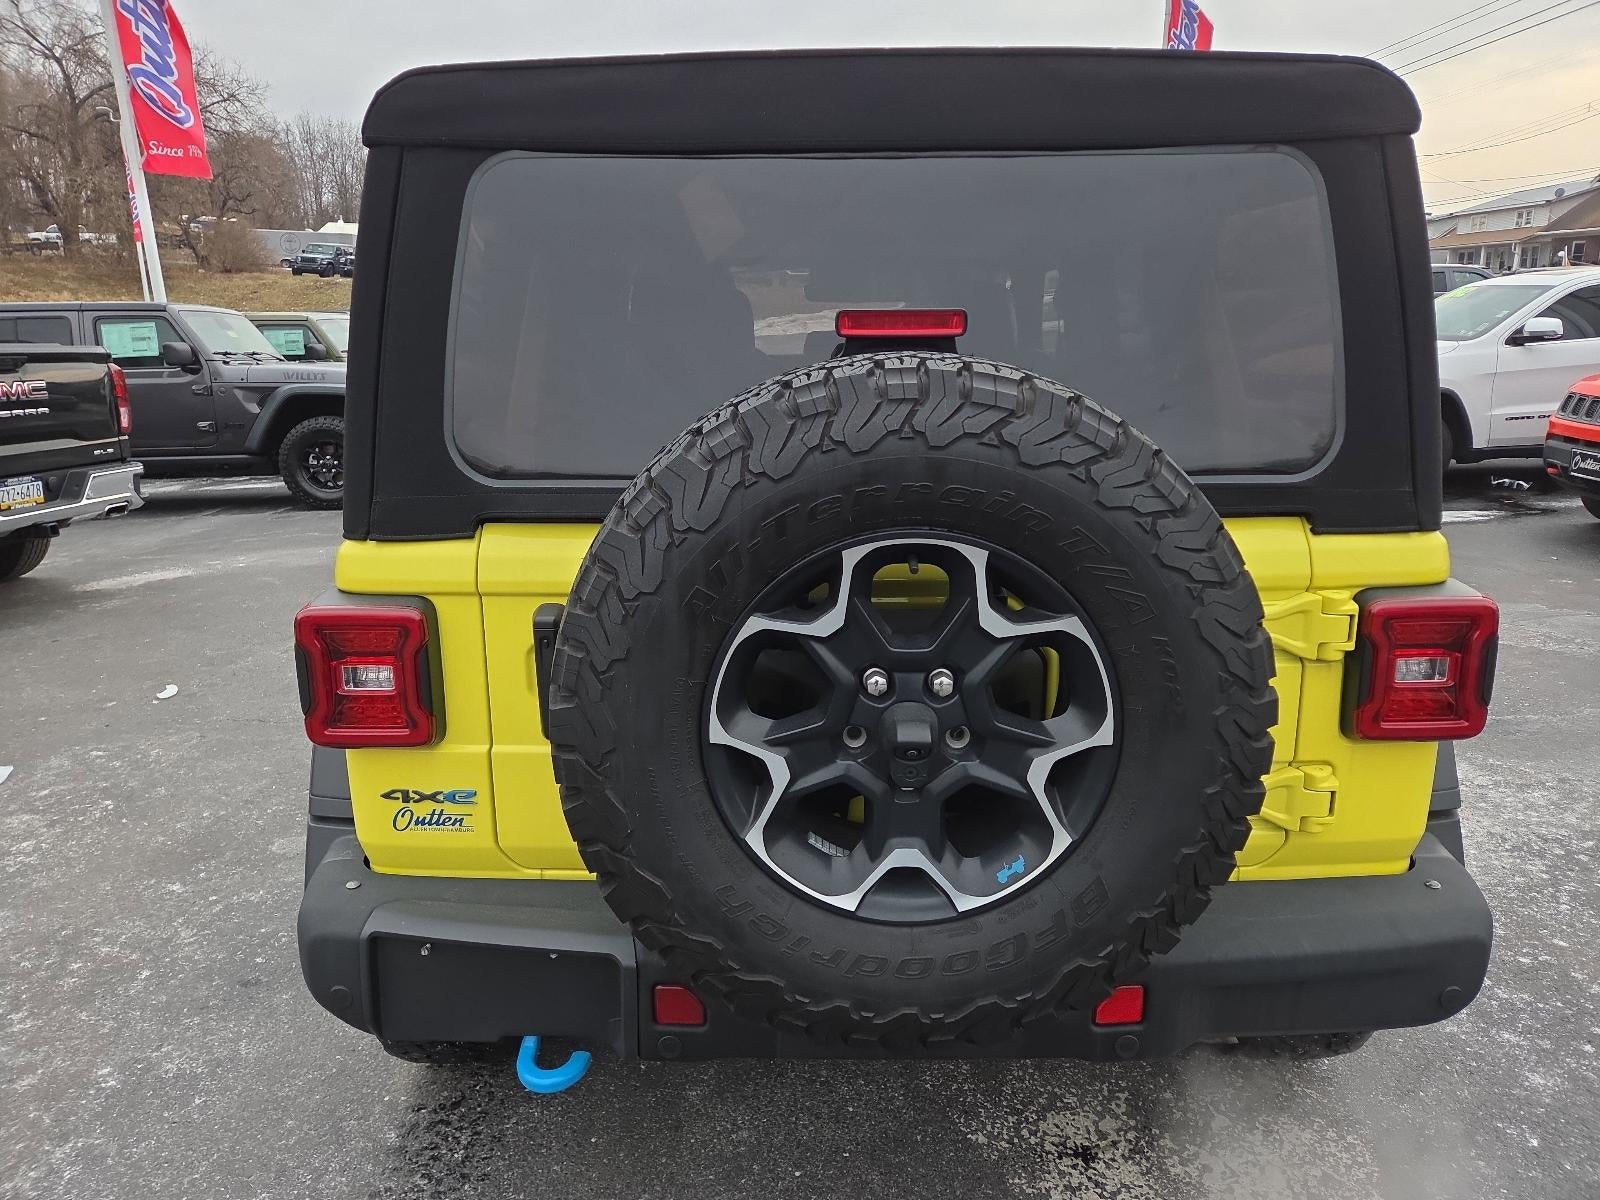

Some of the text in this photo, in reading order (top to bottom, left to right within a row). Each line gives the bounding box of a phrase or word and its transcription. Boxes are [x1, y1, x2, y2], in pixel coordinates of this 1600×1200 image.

[149, 140, 184, 157] Since
[282, 371, 327, 381] WILLYS
[392, 806, 474, 832] Outten
[711, 872, 1112, 979] BFGoodrich
